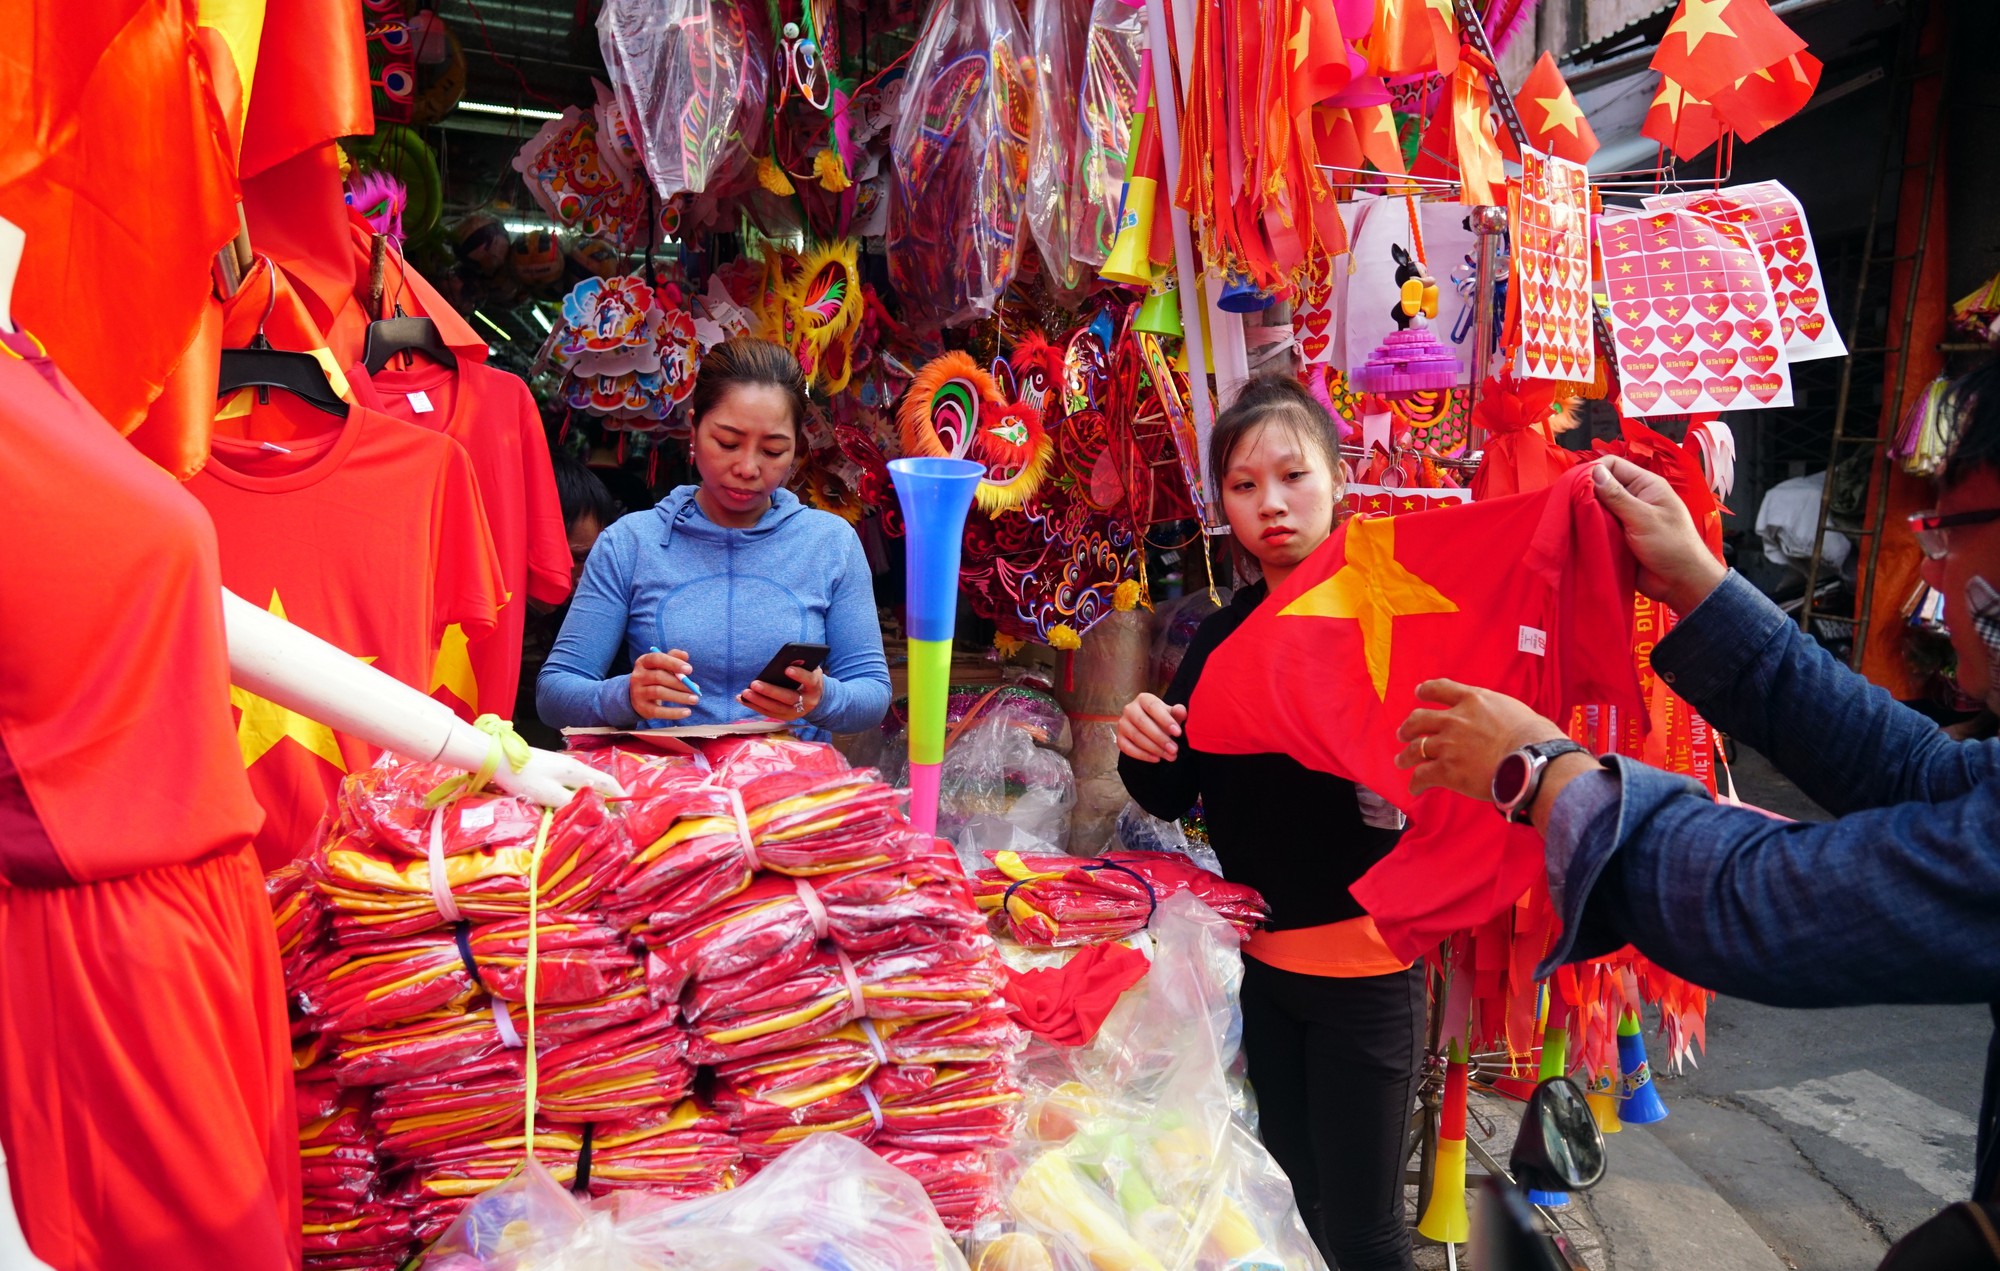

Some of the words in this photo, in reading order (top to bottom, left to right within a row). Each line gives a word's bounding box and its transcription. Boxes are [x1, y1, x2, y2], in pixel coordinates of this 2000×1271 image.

[1634, 591, 1655, 632] ĐỊC
[1635, 641, 1654, 669] VÔ
[1691, 714, 1706, 744] NAM
[1692, 750, 1710, 780] VIỆT
